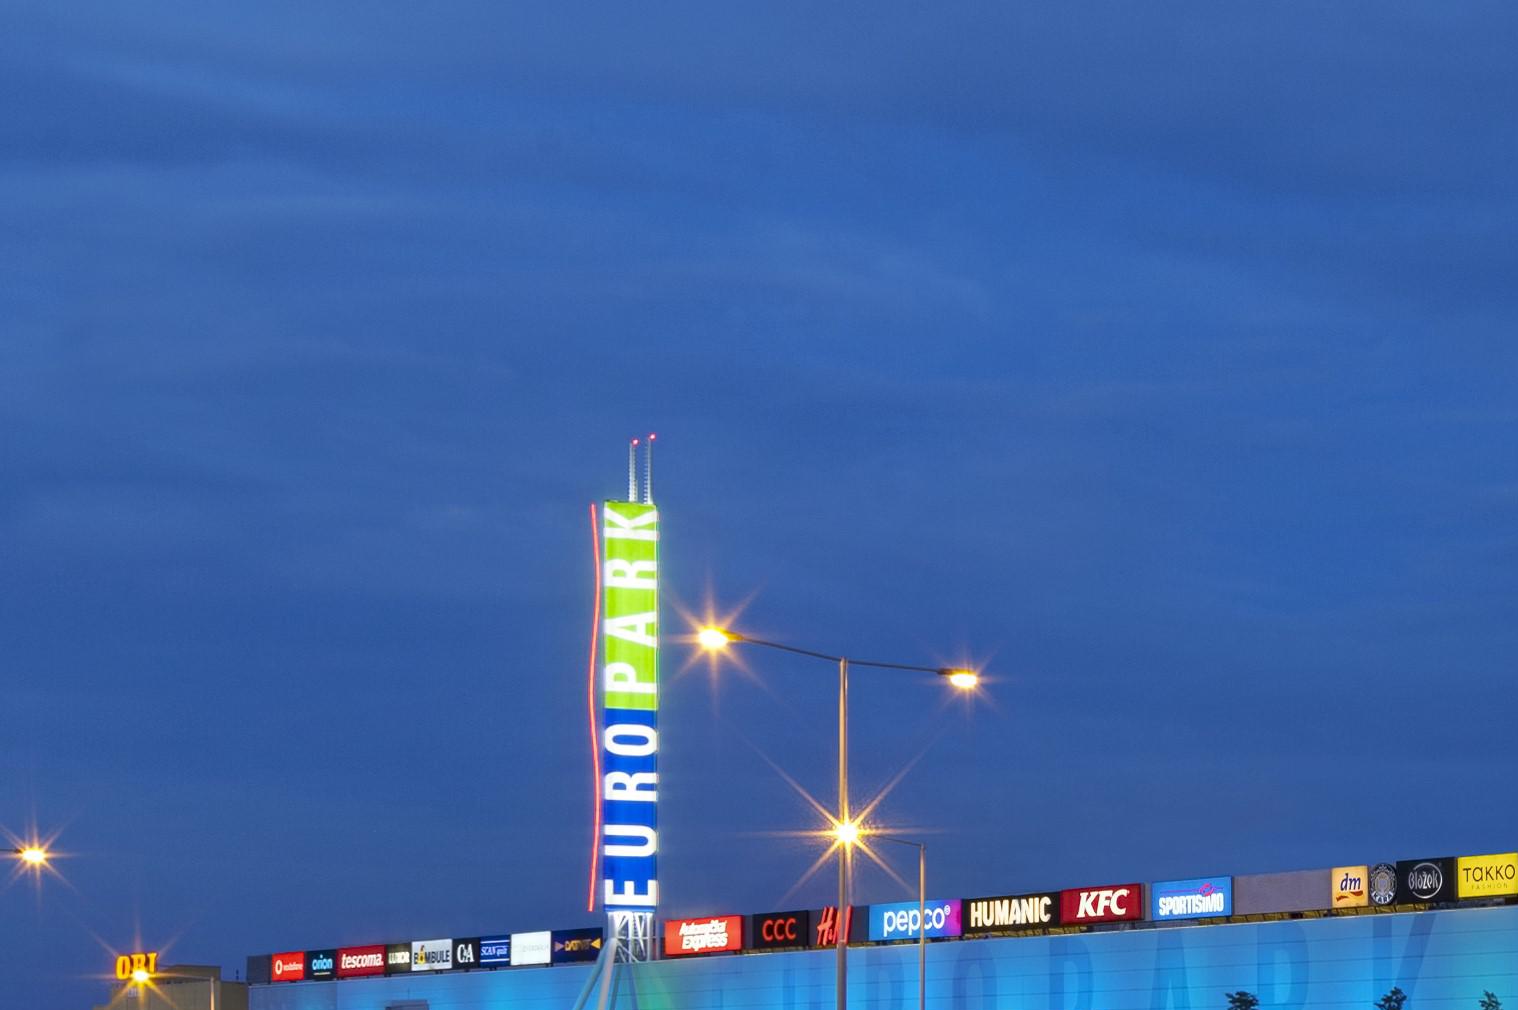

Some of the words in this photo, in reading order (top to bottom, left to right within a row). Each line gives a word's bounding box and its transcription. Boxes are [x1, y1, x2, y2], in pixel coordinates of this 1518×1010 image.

[603, 503, 658, 907] EUROPARK
[1340, 873, 1361, 891] dm
[1471, 882, 1508, 890] FASHION
[970, 896, 1051, 927] HUMANIC
[1077, 889, 1129, 918] KFC
[762, 918, 796, 941] CCC
[312, 954, 333, 970] orion
[457, 943, 475, 963] C&A
